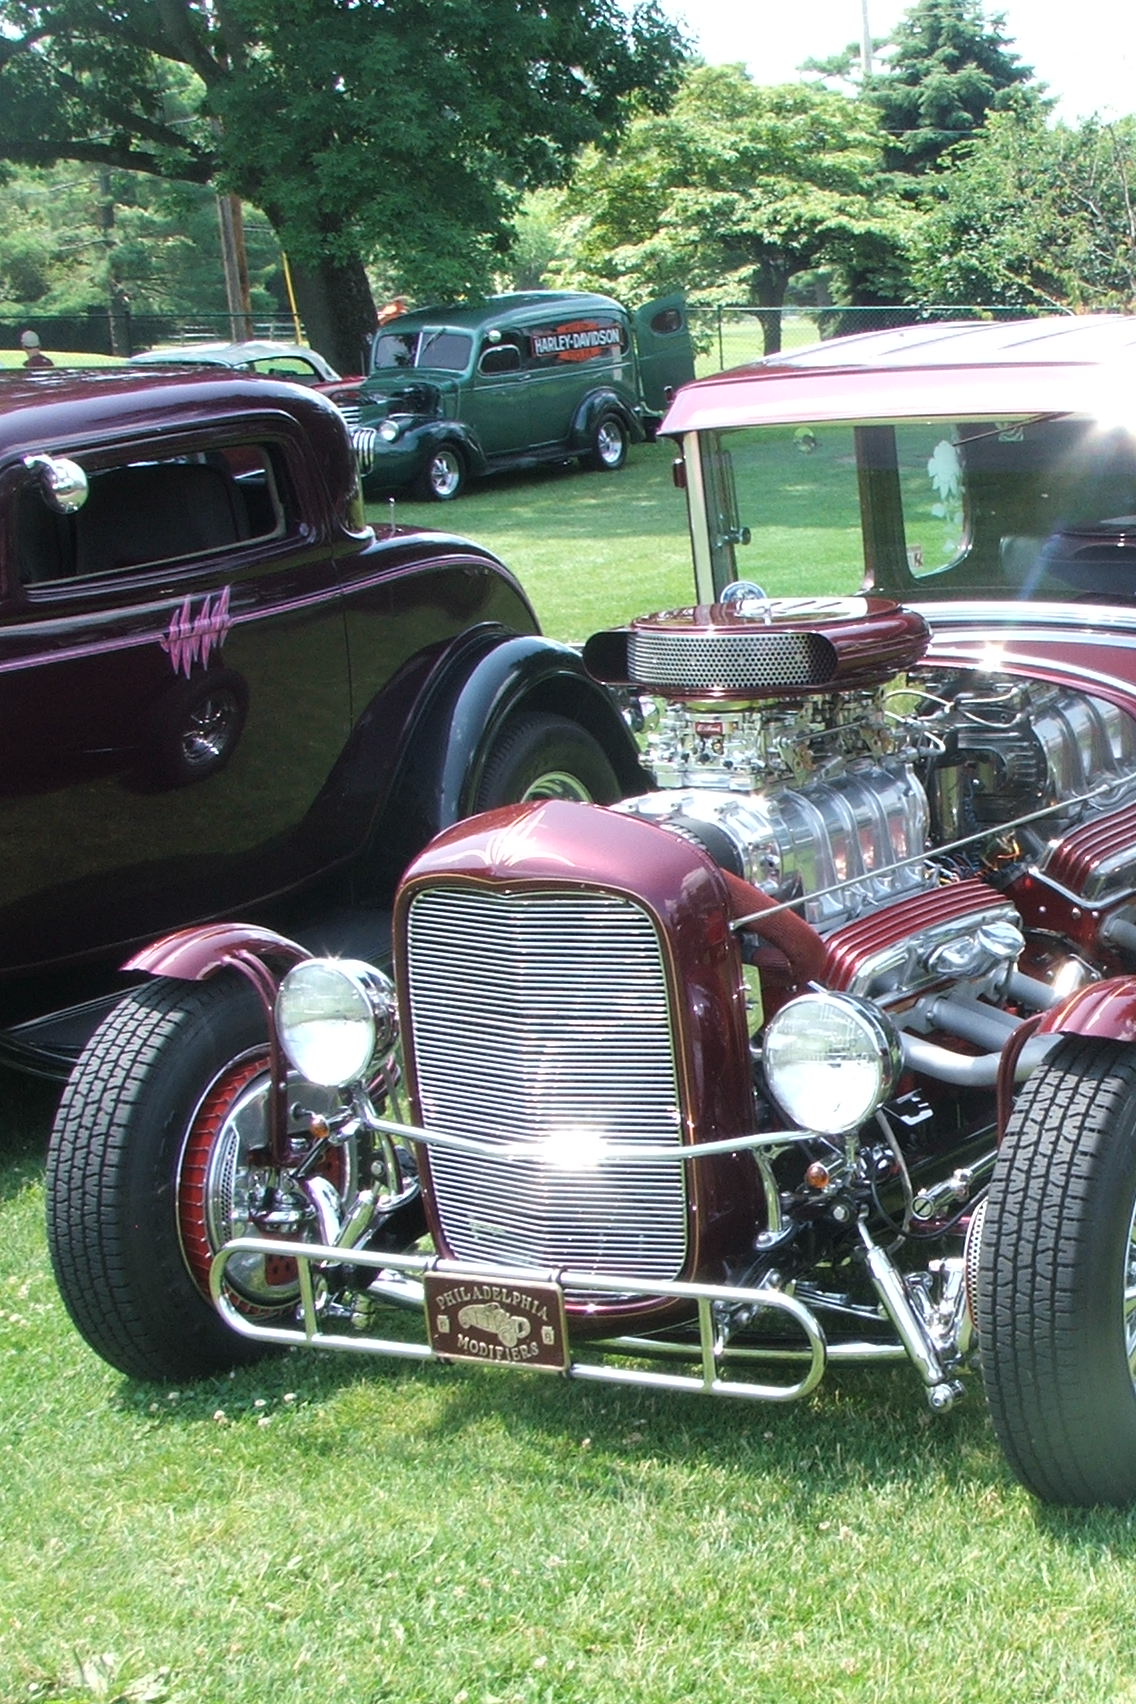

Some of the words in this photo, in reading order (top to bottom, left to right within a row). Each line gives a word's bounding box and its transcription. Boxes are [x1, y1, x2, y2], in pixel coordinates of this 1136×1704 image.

[534, 328, 620, 353] HARLEY-DAVIDSON
[436, 1285, 548, 1321] PHILADELPHIA
[457, 1333, 539, 1361] MODIFIERS
